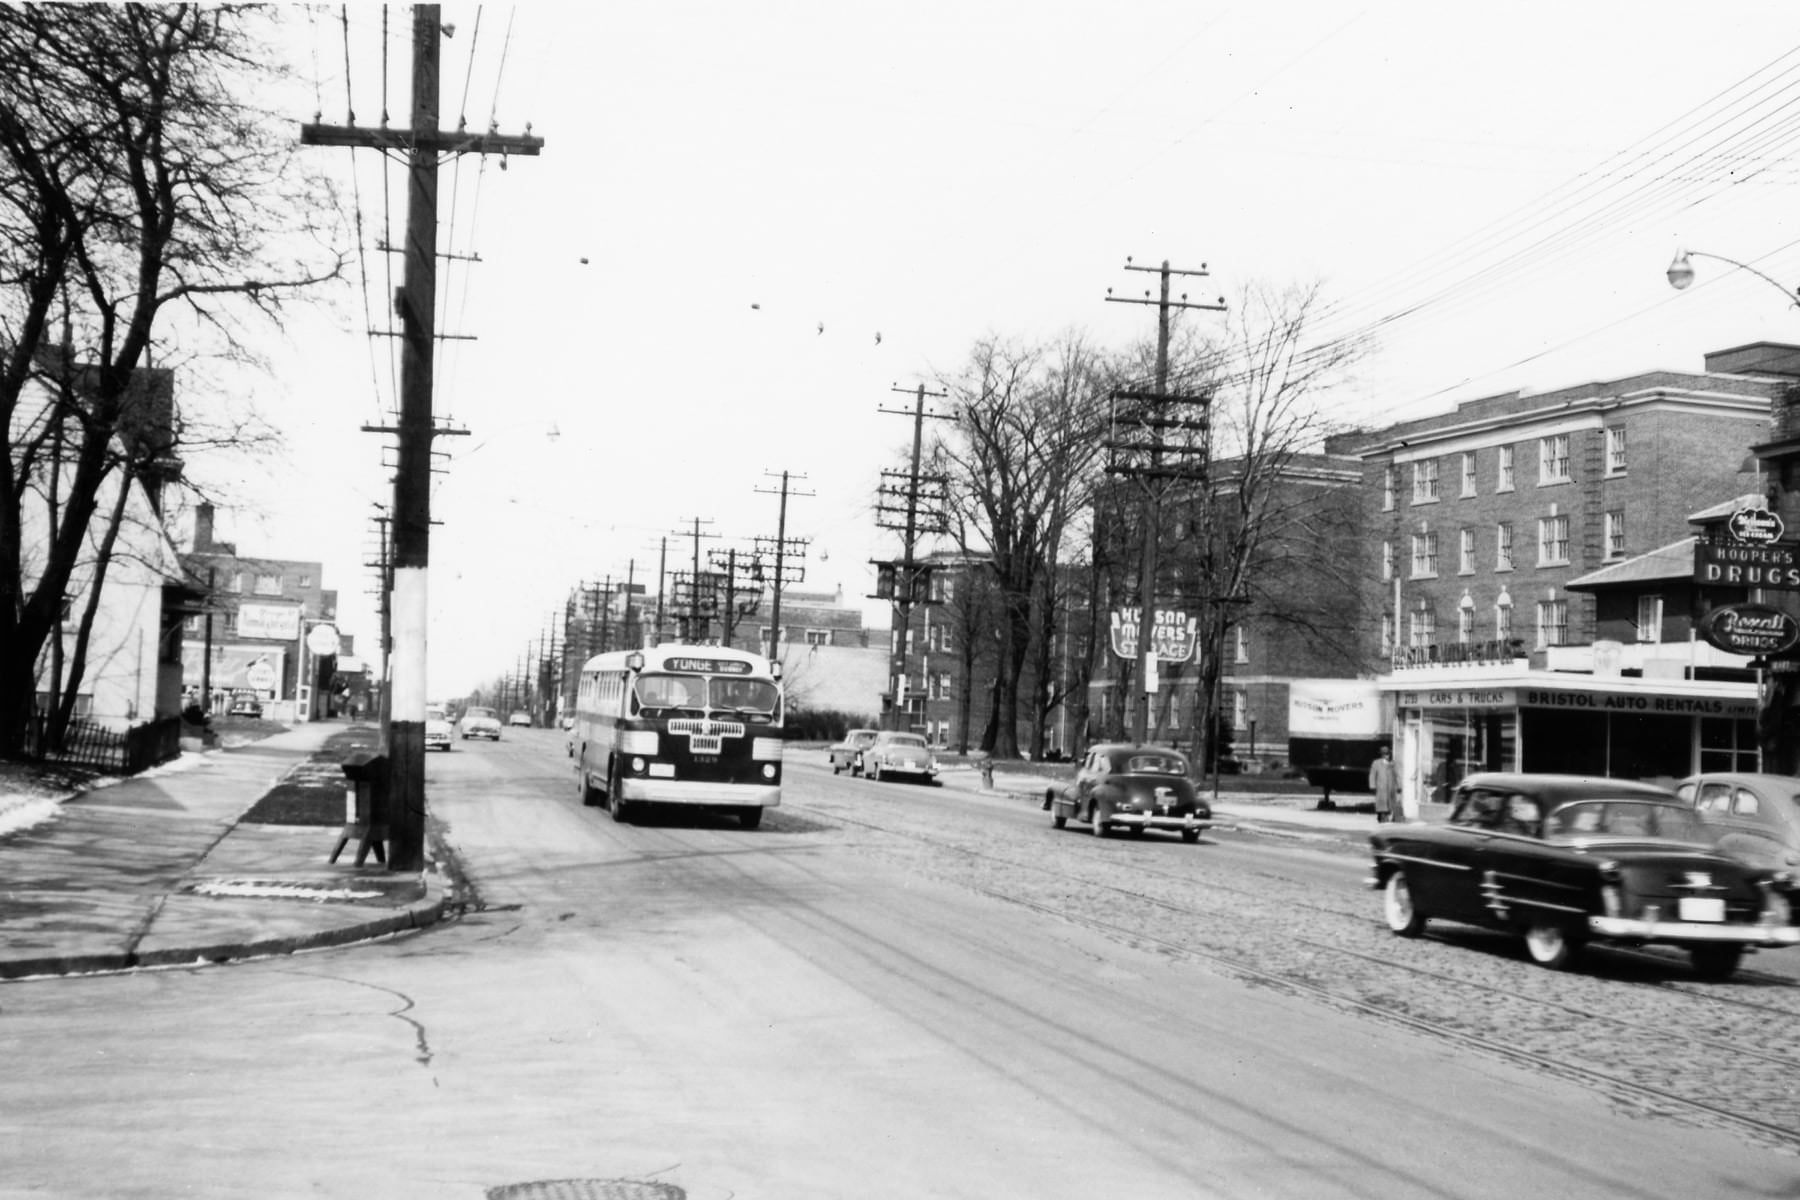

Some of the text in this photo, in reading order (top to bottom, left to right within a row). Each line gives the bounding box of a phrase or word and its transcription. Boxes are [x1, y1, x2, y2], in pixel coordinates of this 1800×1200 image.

[1717, 548, 1793, 564] HOOPER'S
[1707, 563, 1800, 586] DRUGS
[1122, 607, 1186, 625] HUSON
[1122, 624, 1186, 641] MVERS
[1121, 641, 1186, 657] STRAGE
[1731, 634, 1778, 649] DRUGS
[1430, 692, 1452, 704] CARS
[1457, 692, 1464, 703] &
[1469, 691, 1504, 704] TRUCKS
[1528, 691, 1596, 707] BRISTOL
[1604, 695, 1647, 709] AUTO
[1655, 697, 1722, 713] RENTALS
